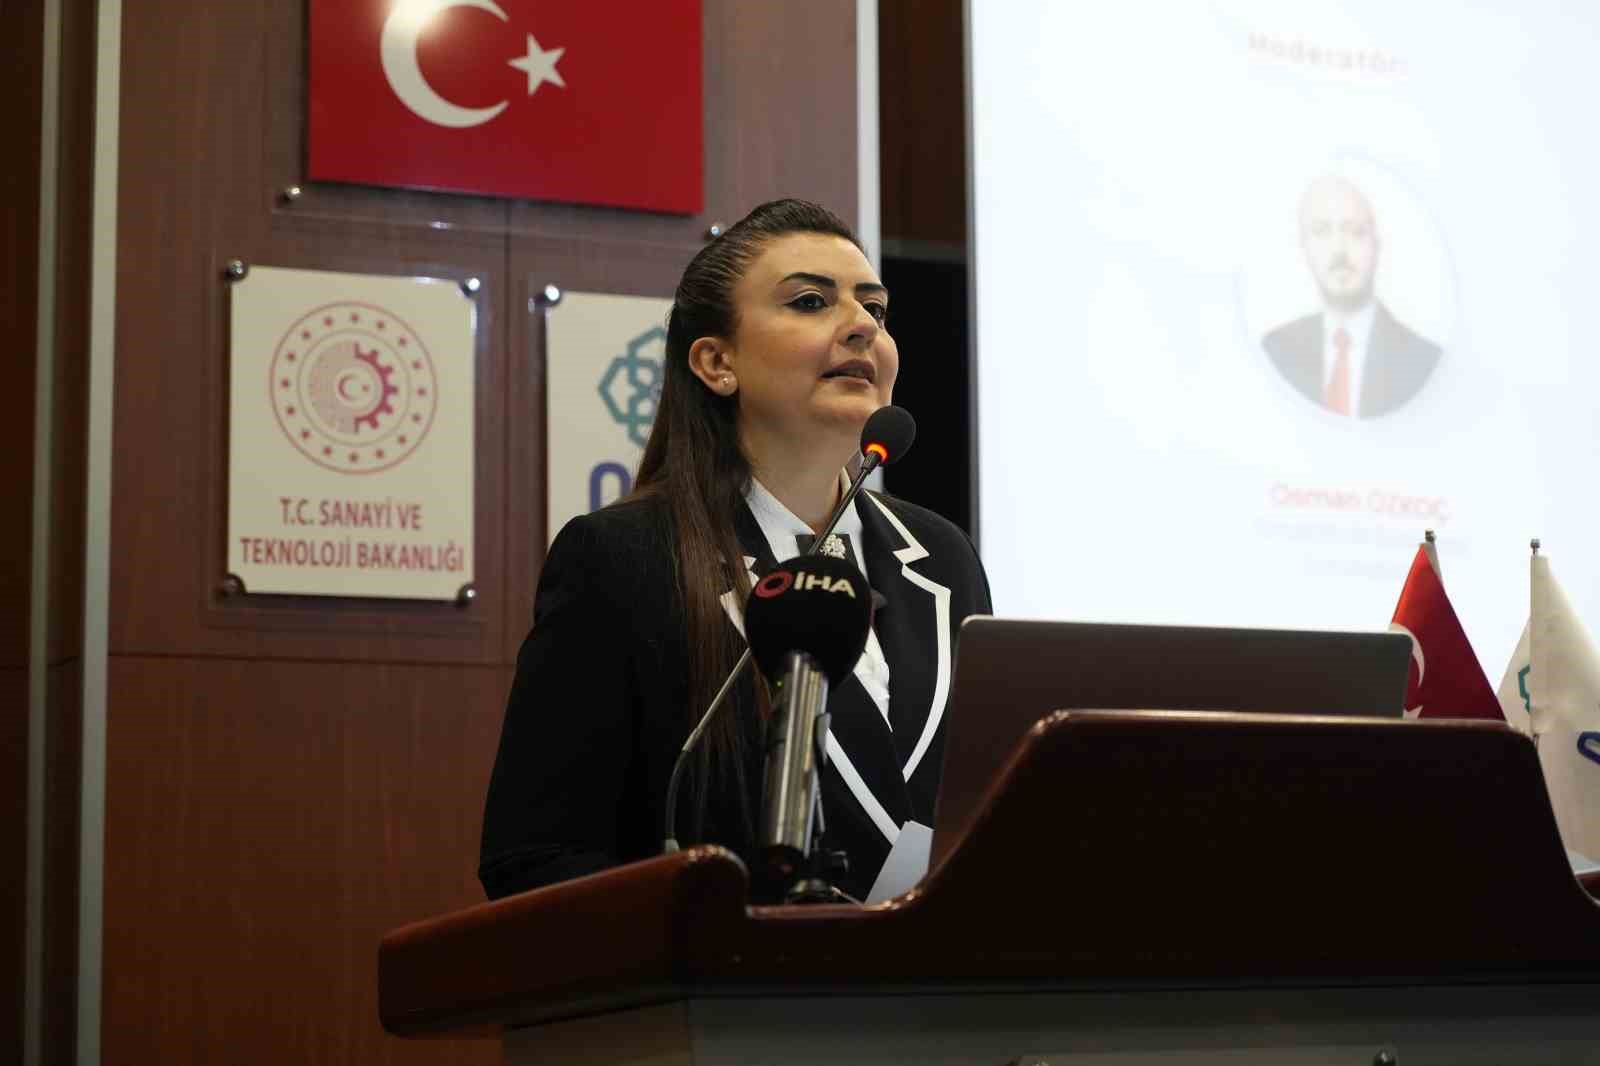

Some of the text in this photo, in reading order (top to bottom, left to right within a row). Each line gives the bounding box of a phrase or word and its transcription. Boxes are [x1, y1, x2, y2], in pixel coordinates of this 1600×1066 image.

[280, 497, 421, 530] T.C. SANAYİ VE
[240, 536, 464, 572] TEKNOLOJİ BAKANLIĞI
